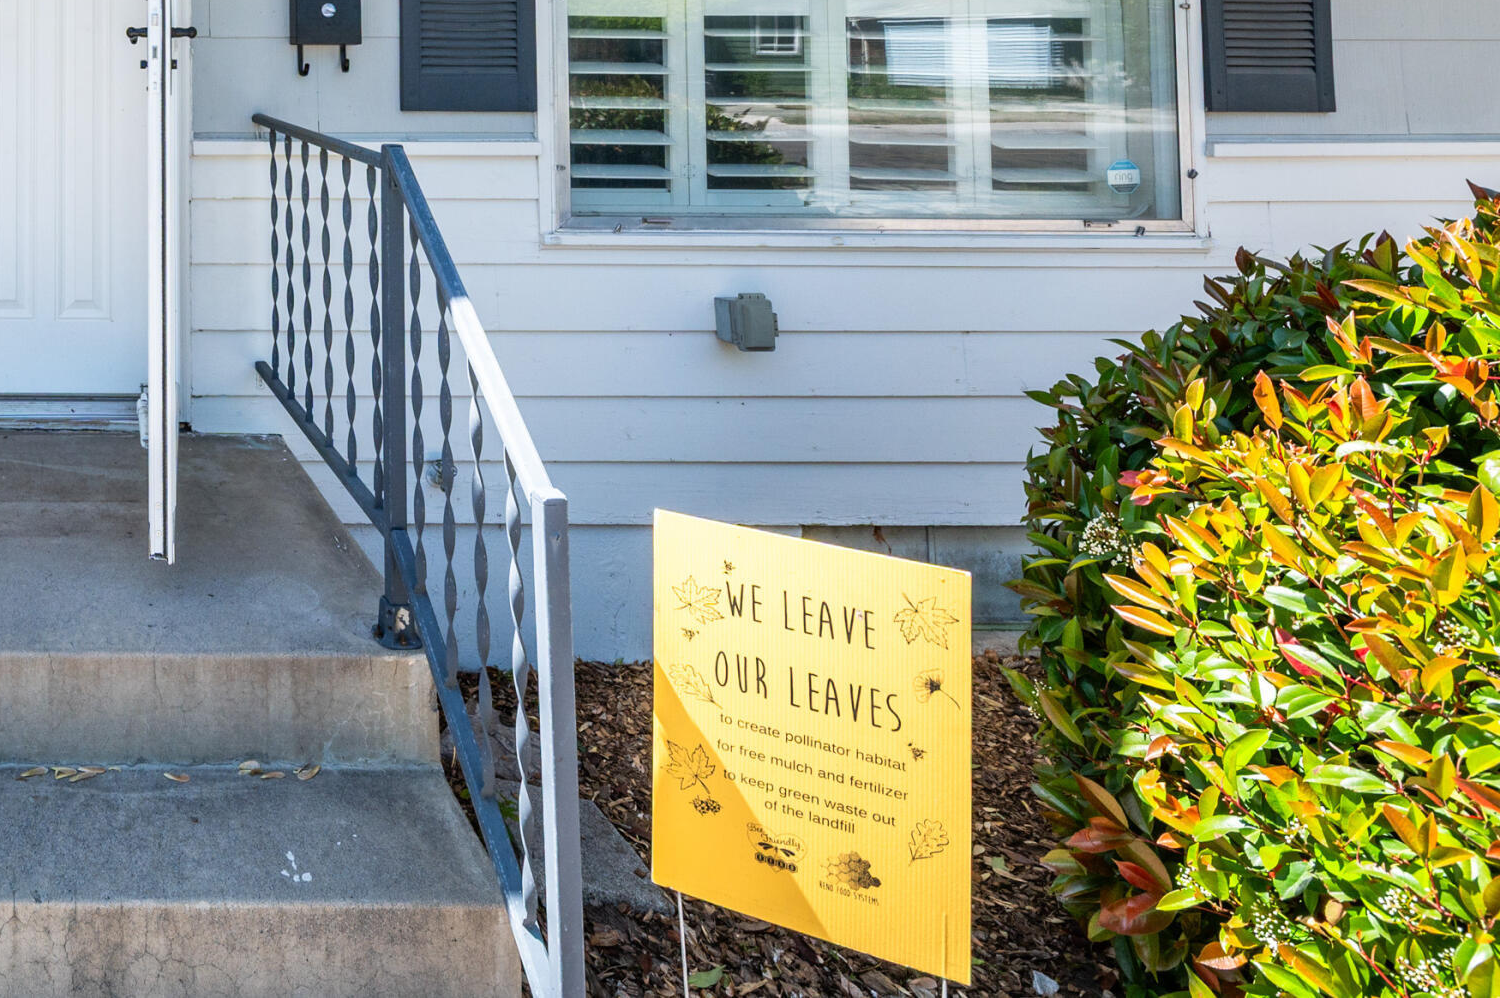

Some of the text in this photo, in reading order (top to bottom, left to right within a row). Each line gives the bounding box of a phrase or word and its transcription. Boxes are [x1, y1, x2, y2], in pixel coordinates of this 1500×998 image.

[1114, 172, 1133, 183] ring
[725, 581, 876, 650] WE LEAVE
[714, 651, 902, 732] OUR LEAVES
[717, 738, 909, 801] for free mulch and fertilizer
[720, 713, 907, 772] to create pollinator habitat
[723, 769, 897, 828] to keep green waste out
[764, 800, 855, 834] of the landfill
